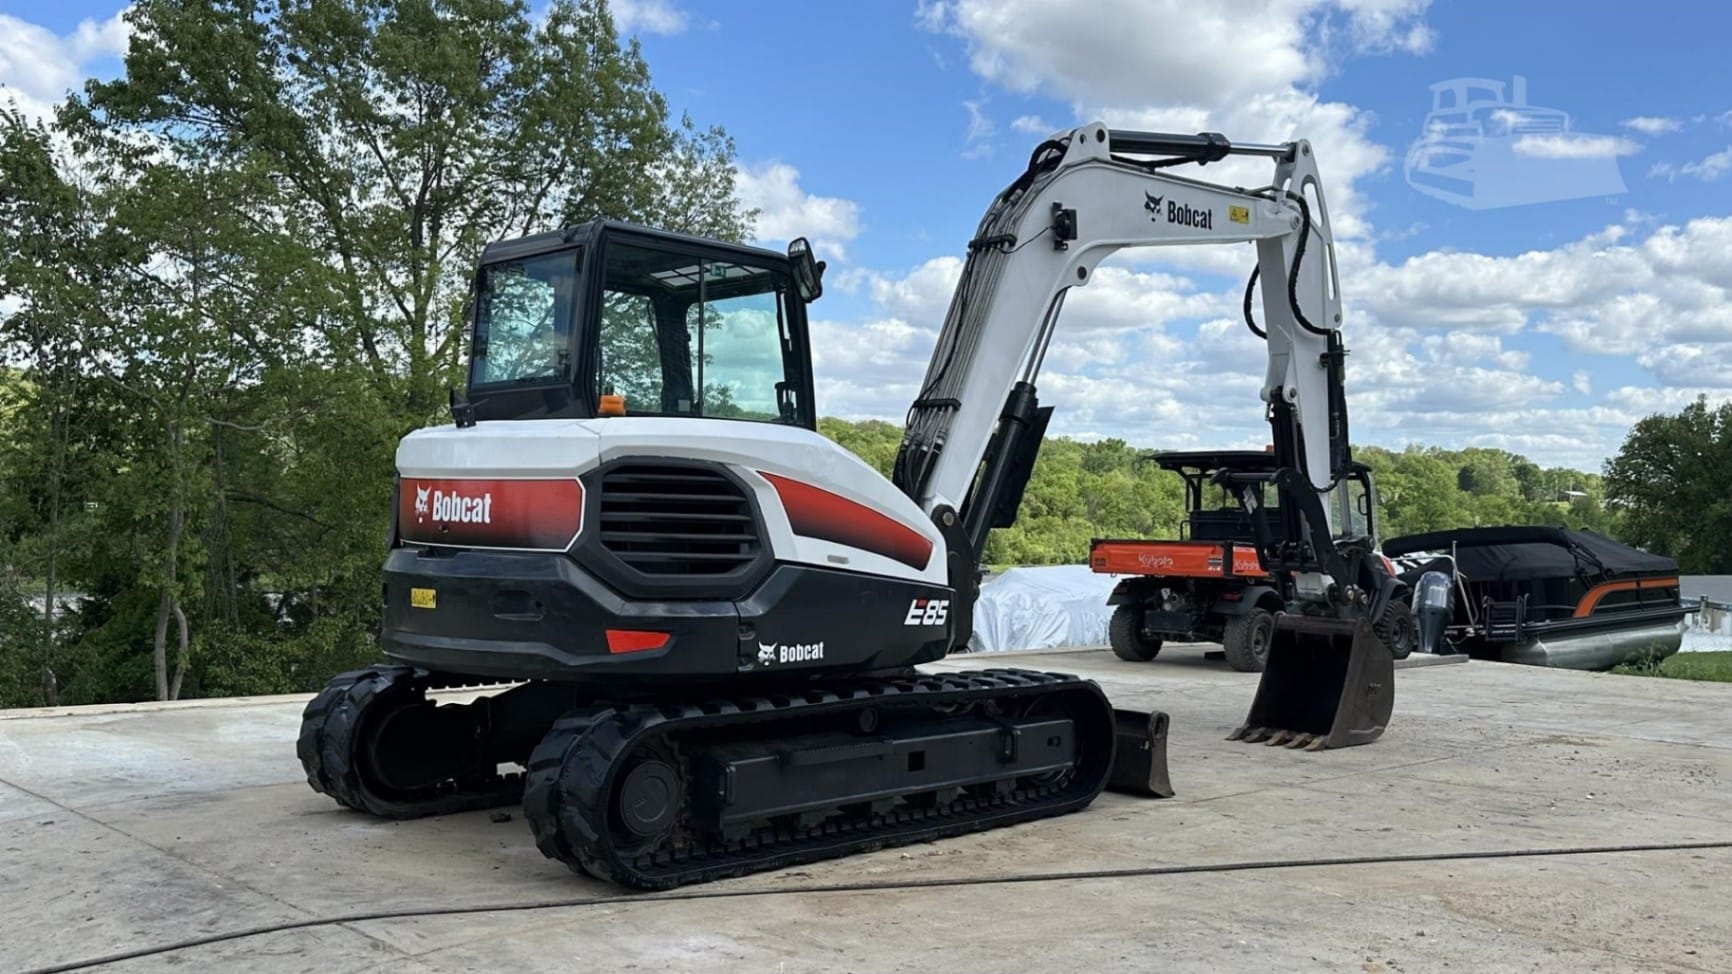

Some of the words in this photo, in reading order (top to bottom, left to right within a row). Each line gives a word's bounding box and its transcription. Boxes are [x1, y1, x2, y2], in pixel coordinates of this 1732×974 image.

[1167, 200, 1213, 230] Bobcat
[432, 491, 491, 524] Bobcat
[1138, 553, 1174, 567] Kubota
[904, 599, 949, 626] E85
[779, 641, 825, 663] Bobcat
